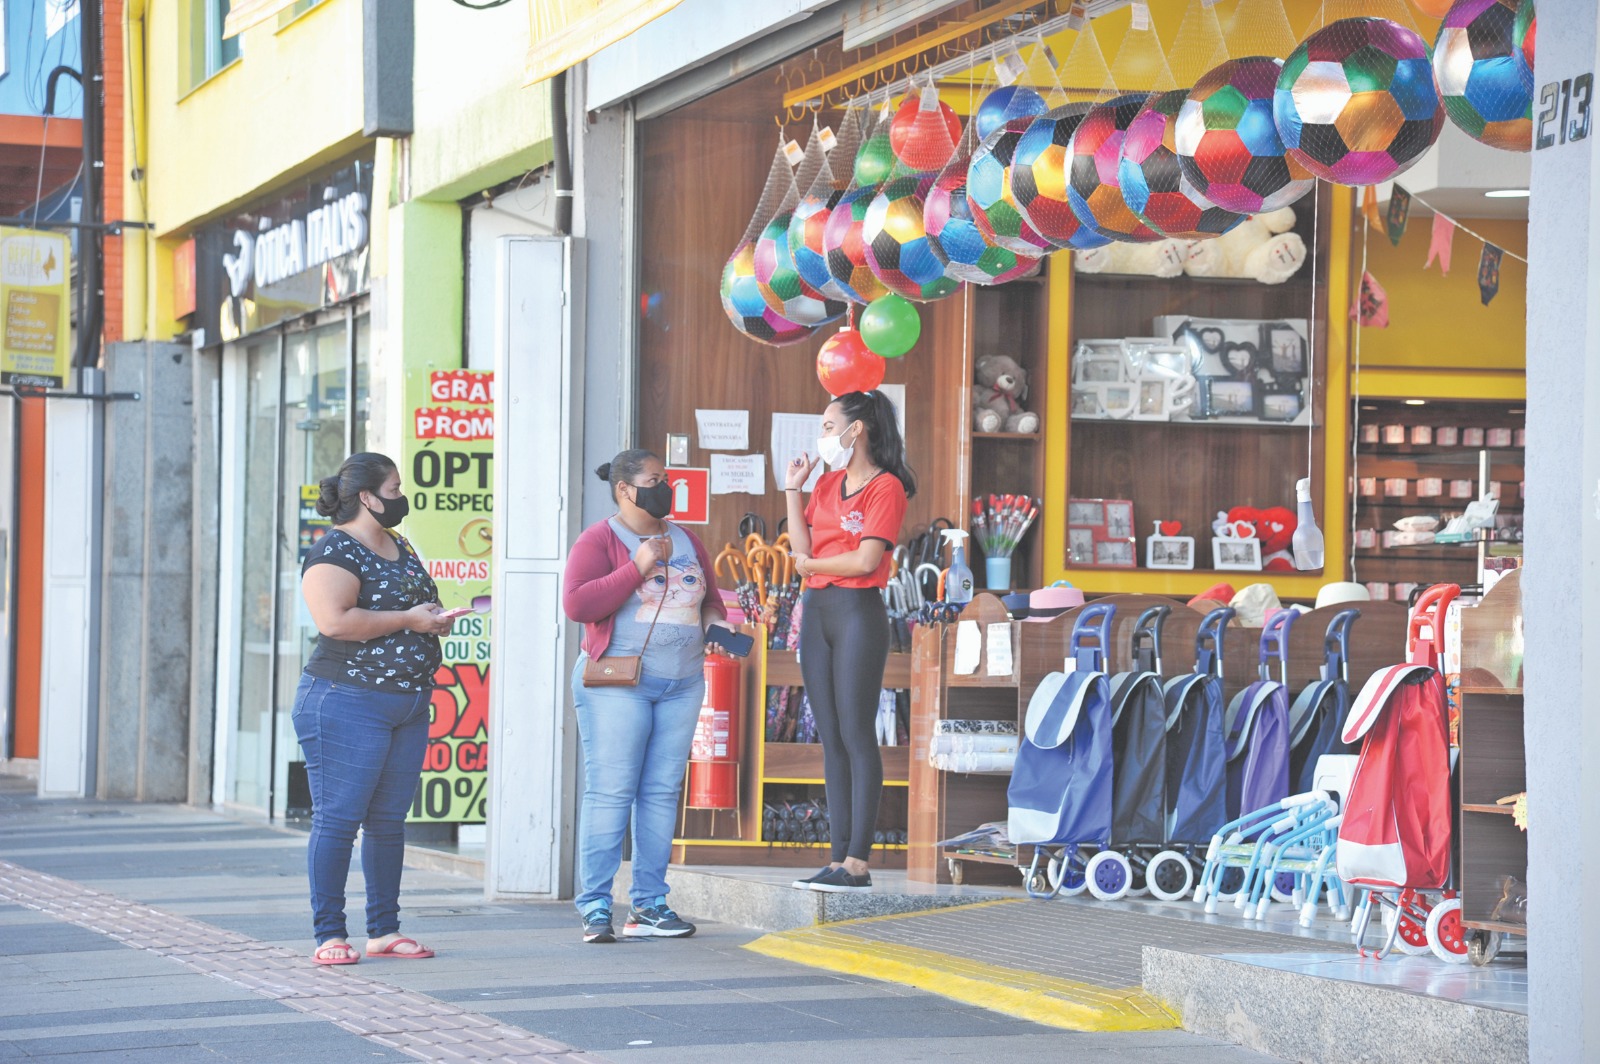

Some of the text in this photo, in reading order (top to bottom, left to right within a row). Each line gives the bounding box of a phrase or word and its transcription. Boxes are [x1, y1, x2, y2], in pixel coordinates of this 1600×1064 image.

[1536, 72, 1594, 150] 213
[255, 186, 367, 288] ÓTICA ITÁLYS
[414, 492, 427, 510] O
[445, 641, 469, 660] OU
